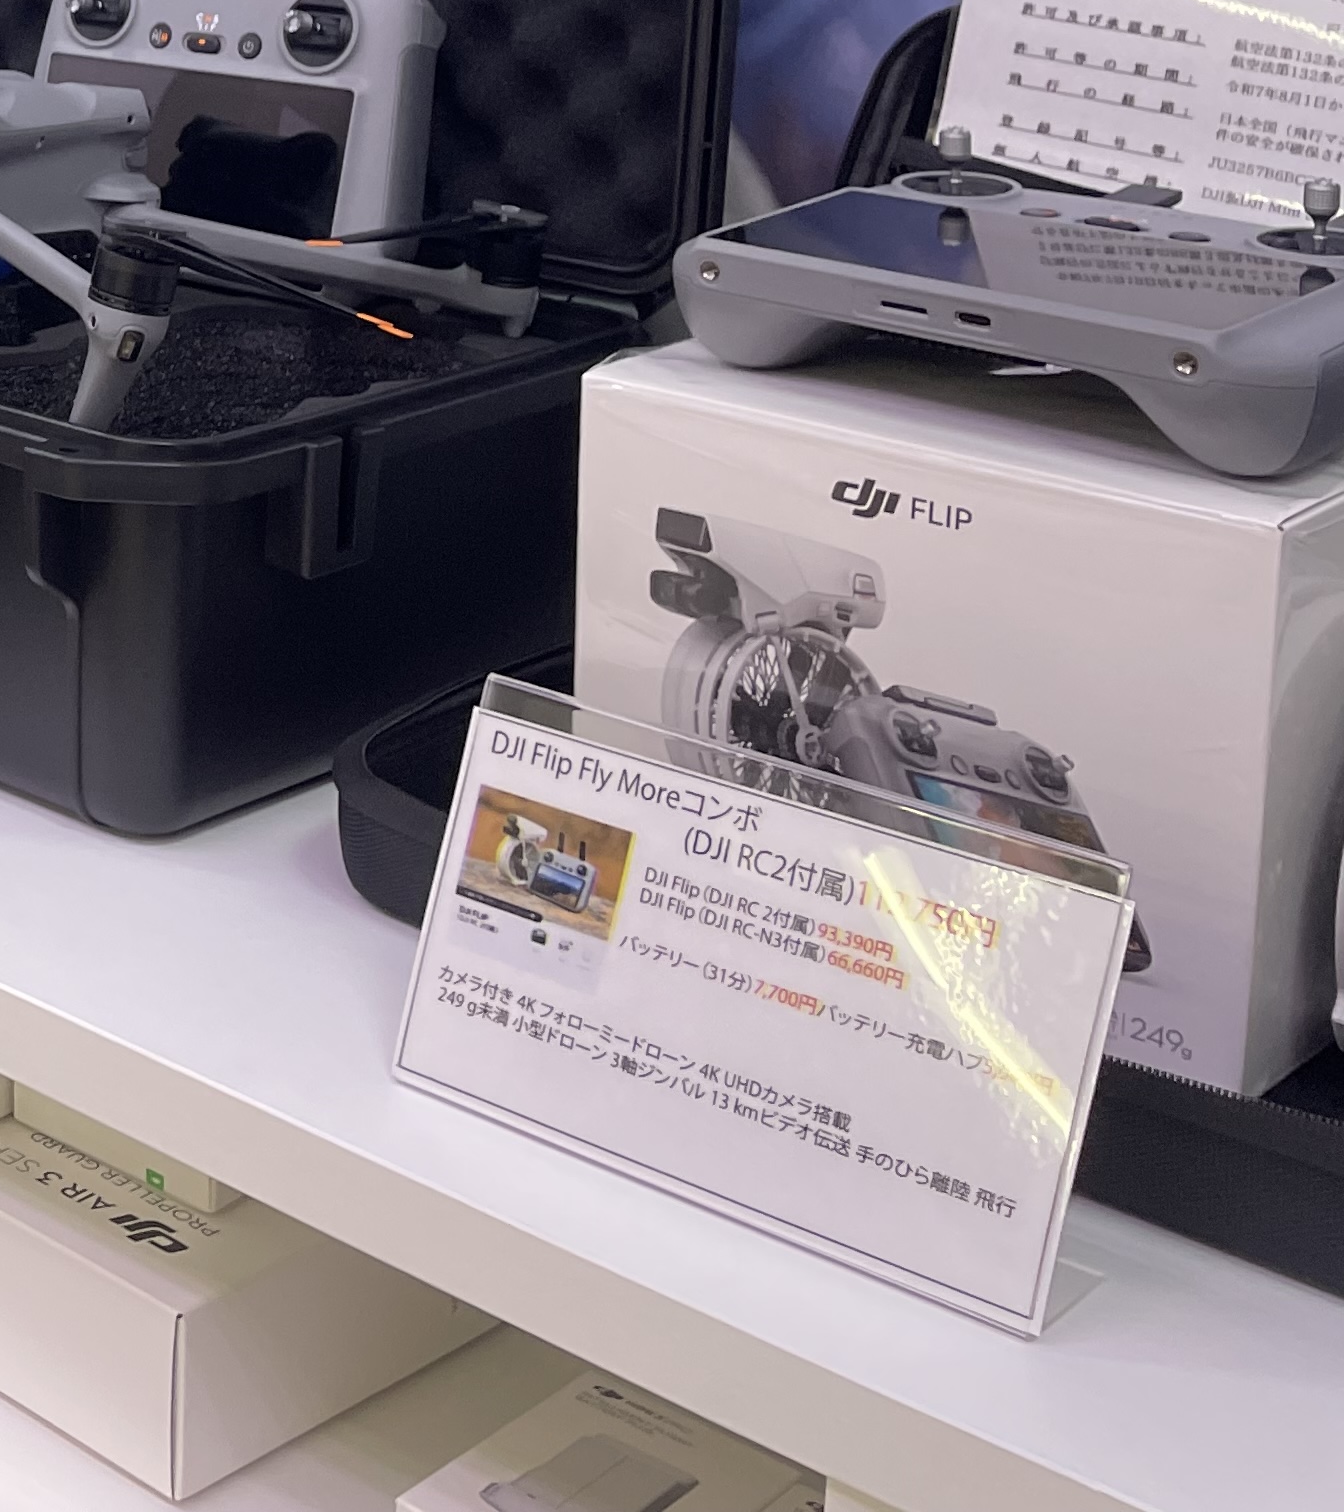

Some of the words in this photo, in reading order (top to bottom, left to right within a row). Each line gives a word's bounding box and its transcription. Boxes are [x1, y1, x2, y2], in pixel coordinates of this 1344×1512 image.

[1219, 112, 1344, 146] 日本全国（飛行マ
[910, 496, 974, 531] FLIP
[491, 729, 527, 761] DJI
[530, 741, 573, 779] Flip
[578, 756, 614, 792] Fly
[617, 768, 763, 831] Moreコンボ
[684, 826, 732, 864] (DJI
[639, 887, 663, 909] DJI
[666, 896, 696, 920] Flip
[698, 905, 729, 931] (DJI
[644, 866, 669, 888] DJI
[671, 875, 700, 898] Flip
[703, 884, 735, 911] (DJI
[736, 897, 759, 918] RC
[619, 935, 700, 969] バッテリー
[438, 965, 514, 1005] カメラ付き
[516, 996, 536, 1014] 4K
[540, 1001, 696, 1072] フォローミードローン
[699, 1063, 722, 1084] 4K
[723, 1069, 853, 1134] UHDカメラ搭載
[437, 986, 465, 1007] 249
[467, 1000, 511, 1028] g未満
[512, 1014, 608, 1062] 小型ドローン
[610, 1052, 706, 1100] 3軸ジンバル
[711, 1089, 730, 1111] 13
[733, 1096, 852, 1159] kmビデオ伝送
[855, 1144, 972, 1204] 手のひら離陸
[973, 1186, 1018, 1219] 飛行
[29, 1131, 100, 1171] GUARD
[34, 1170, 63, 1187] 3
[60, 1181, 116, 1211] AIR
[98, 1165, 221, 1238] PROPELLER
